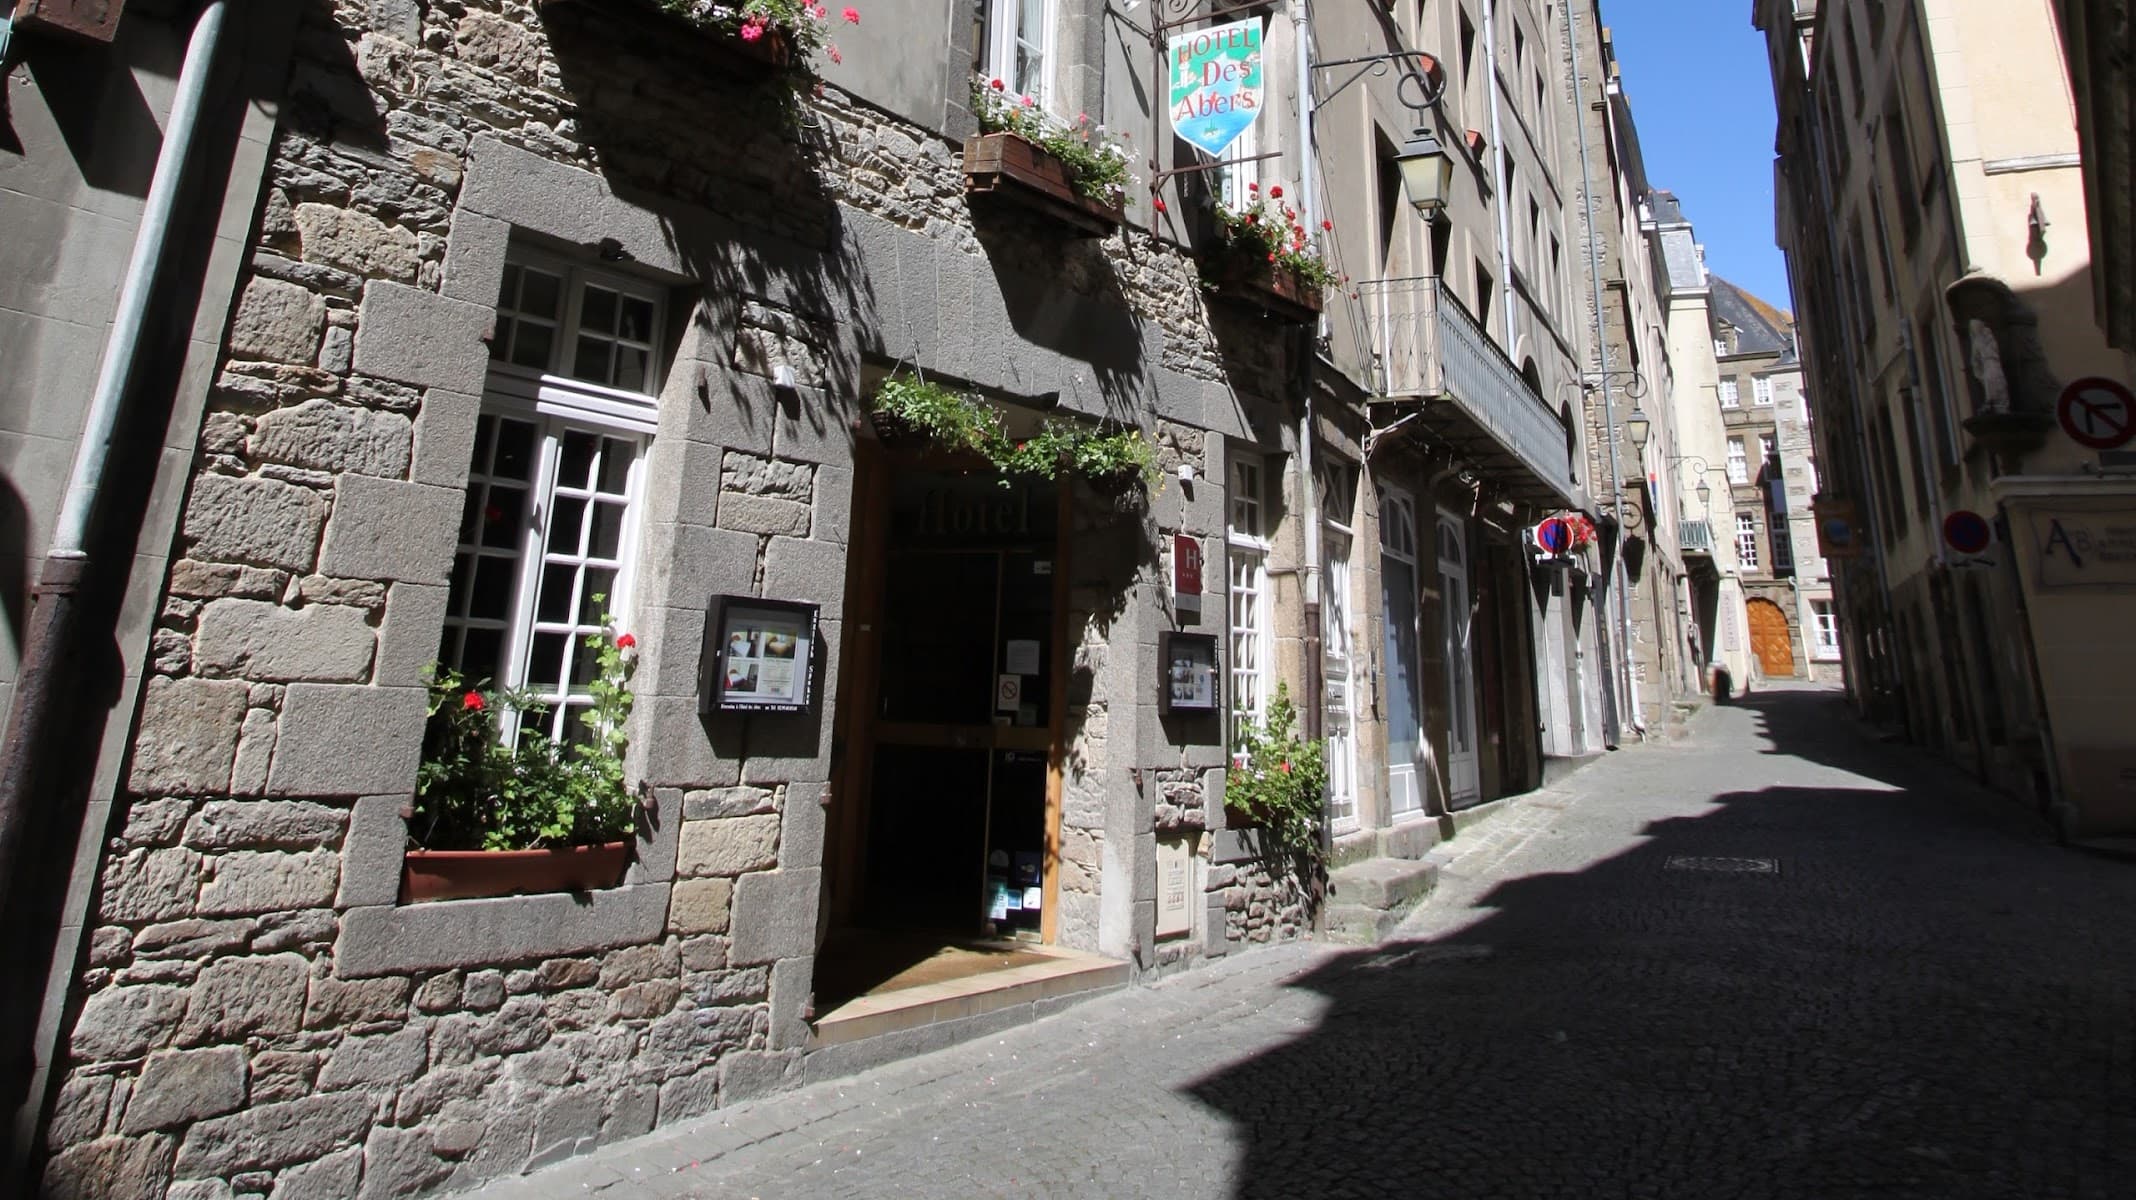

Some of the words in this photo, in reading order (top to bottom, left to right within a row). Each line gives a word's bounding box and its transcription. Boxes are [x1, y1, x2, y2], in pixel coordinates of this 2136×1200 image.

[1177, 27, 1256, 62] HOTEL
[1202, 60, 1251, 87] Des
[1174, 90, 1256, 121] Abers
[1186, 548, 1198, 570] H
